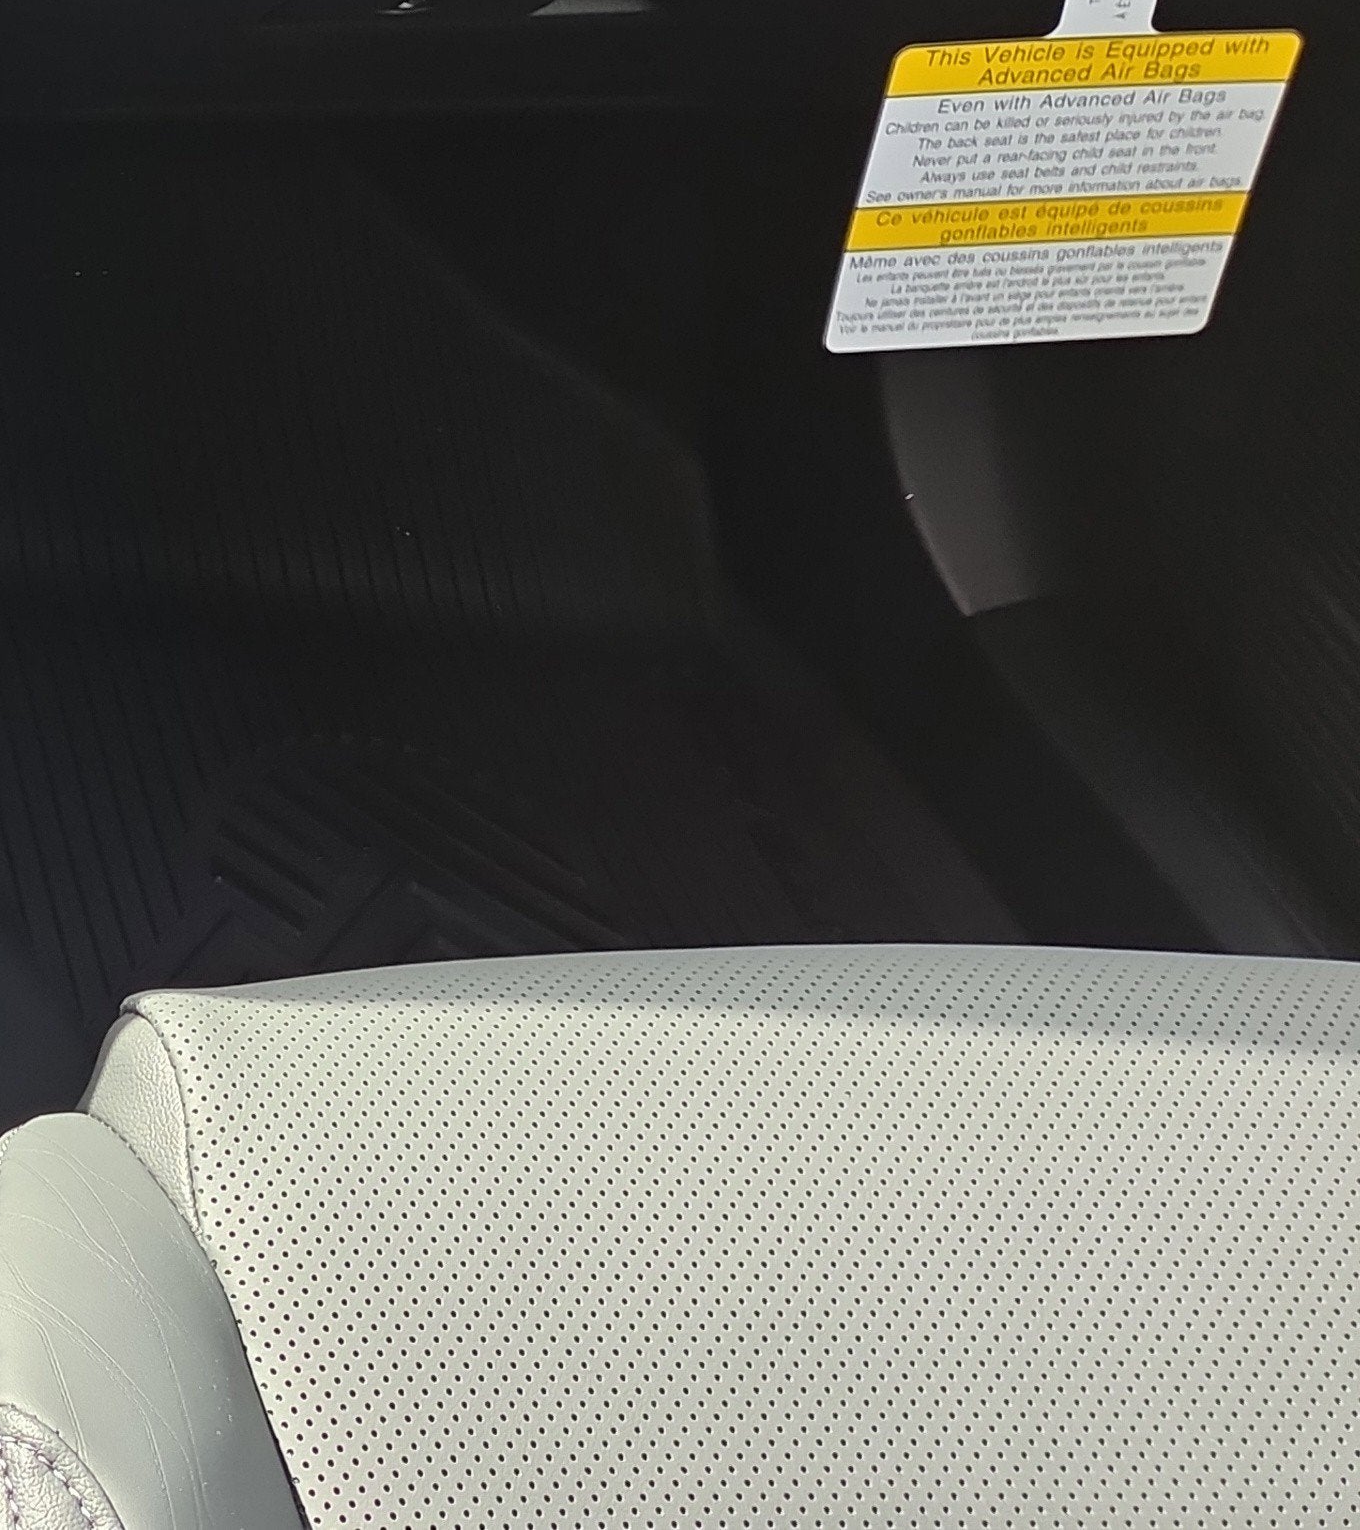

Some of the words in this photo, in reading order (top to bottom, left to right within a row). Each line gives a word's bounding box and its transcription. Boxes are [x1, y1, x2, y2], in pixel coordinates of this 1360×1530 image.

[927, 48, 971, 67] This
[985, 44, 1065, 64] Vehicle
[1076, 42, 1095, 60] is
[1106, 38, 1215, 61] Equipped
[1226, 37, 1269, 54] with
[978, 65, 1092, 86] Advanced
[1101, 63, 1134, 81] Air
[1144, 61, 1201, 83] Bags
[938, 98, 984, 114] Even
[994, 95, 1030, 111] with
[1040, 90, 1135, 110] Advanced
[1143, 89, 1171, 106] Air
[1178, 88, 1227, 107] Bags
[885, 121, 939, 136] Children
[944, 120, 969, 132] can
[974, 118, 990, 130] be
[996, 115, 1030, 129] killed
[1035, 115, 1050, 127] or
[1054, 112, 1112, 127] seriously
[1190, 109, 1211, 121] the
[918, 137, 942, 150] The
[947, 135, 977, 149] back
[985, 134, 1012, 147] seat
[1034, 132, 1055, 144] the
[1104, 129, 1141, 143] place
[912, 154, 951, 168] Never
[956, 154, 978, 167] put
[920, 170, 966, 185] Always
[972, 170, 995, 181] use
[866, 190, 891, 203] See
[876, 210, 902, 227] Ce
[911, 205, 989, 225] véhicule
[998, 205, 1027, 221] est
[1035, 200, 1099, 221] équipé
[1108, 200, 1131, 215] de
[1140, 197, 1223, 214] coussins
[940, 222, 1037, 245] gonflables
[1046, 219, 1149, 239] intelligents
[904, 253, 940, 268] avec
[947, 250, 975, 264] des
[982, 248, 1049, 264] coussins
[1056, 243, 1136, 262] gonflables
[1142, 239, 1223, 256] intelligents
